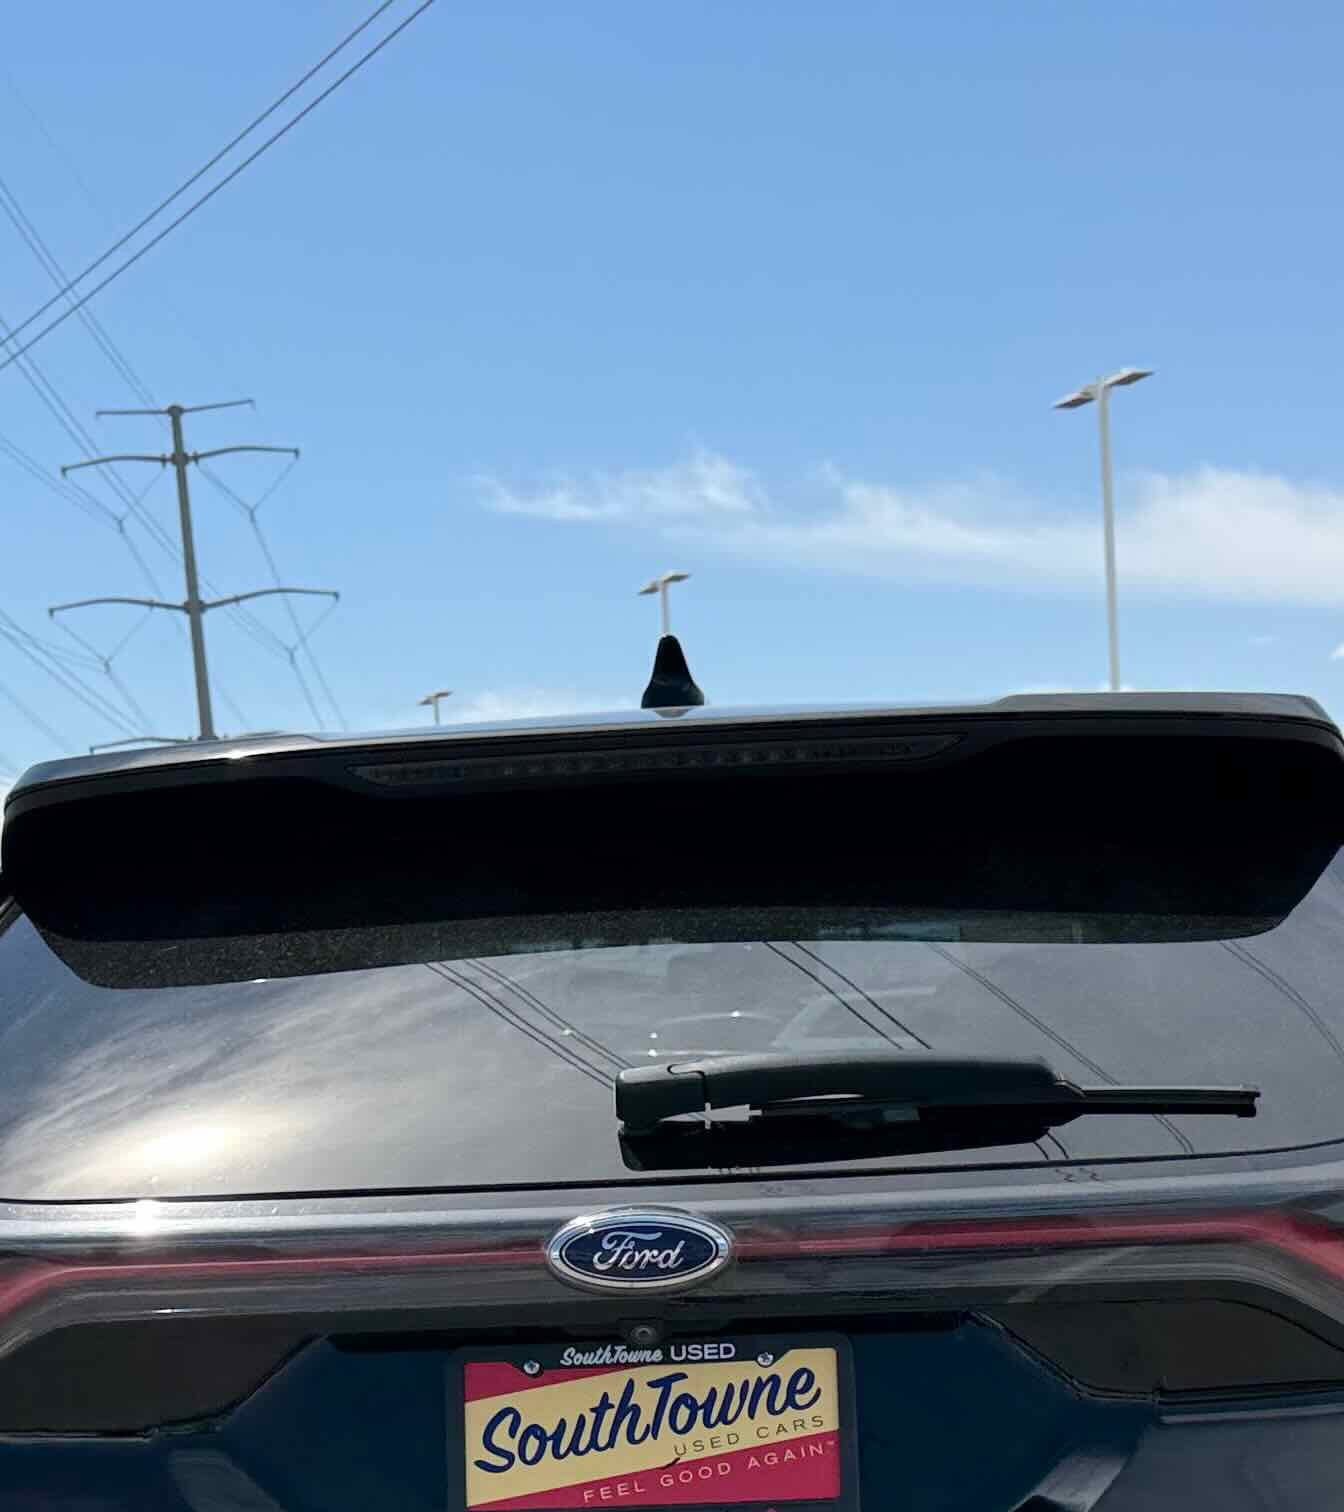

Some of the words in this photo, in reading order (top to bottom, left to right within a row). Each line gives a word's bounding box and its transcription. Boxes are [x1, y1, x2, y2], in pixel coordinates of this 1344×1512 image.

[593, 1231, 684, 1271] Ford
[560, 1343, 663, 1367] SouthTowne
[670, 1343, 736, 1361] USED
[473, 1366, 822, 1475] SouthTowne
[673, 1431, 741, 1458] USED
[756, 1415, 826, 1440] CARS
[583, 1479, 646, 1504] FEEL
[660, 1460, 732, 1489] GOOD
